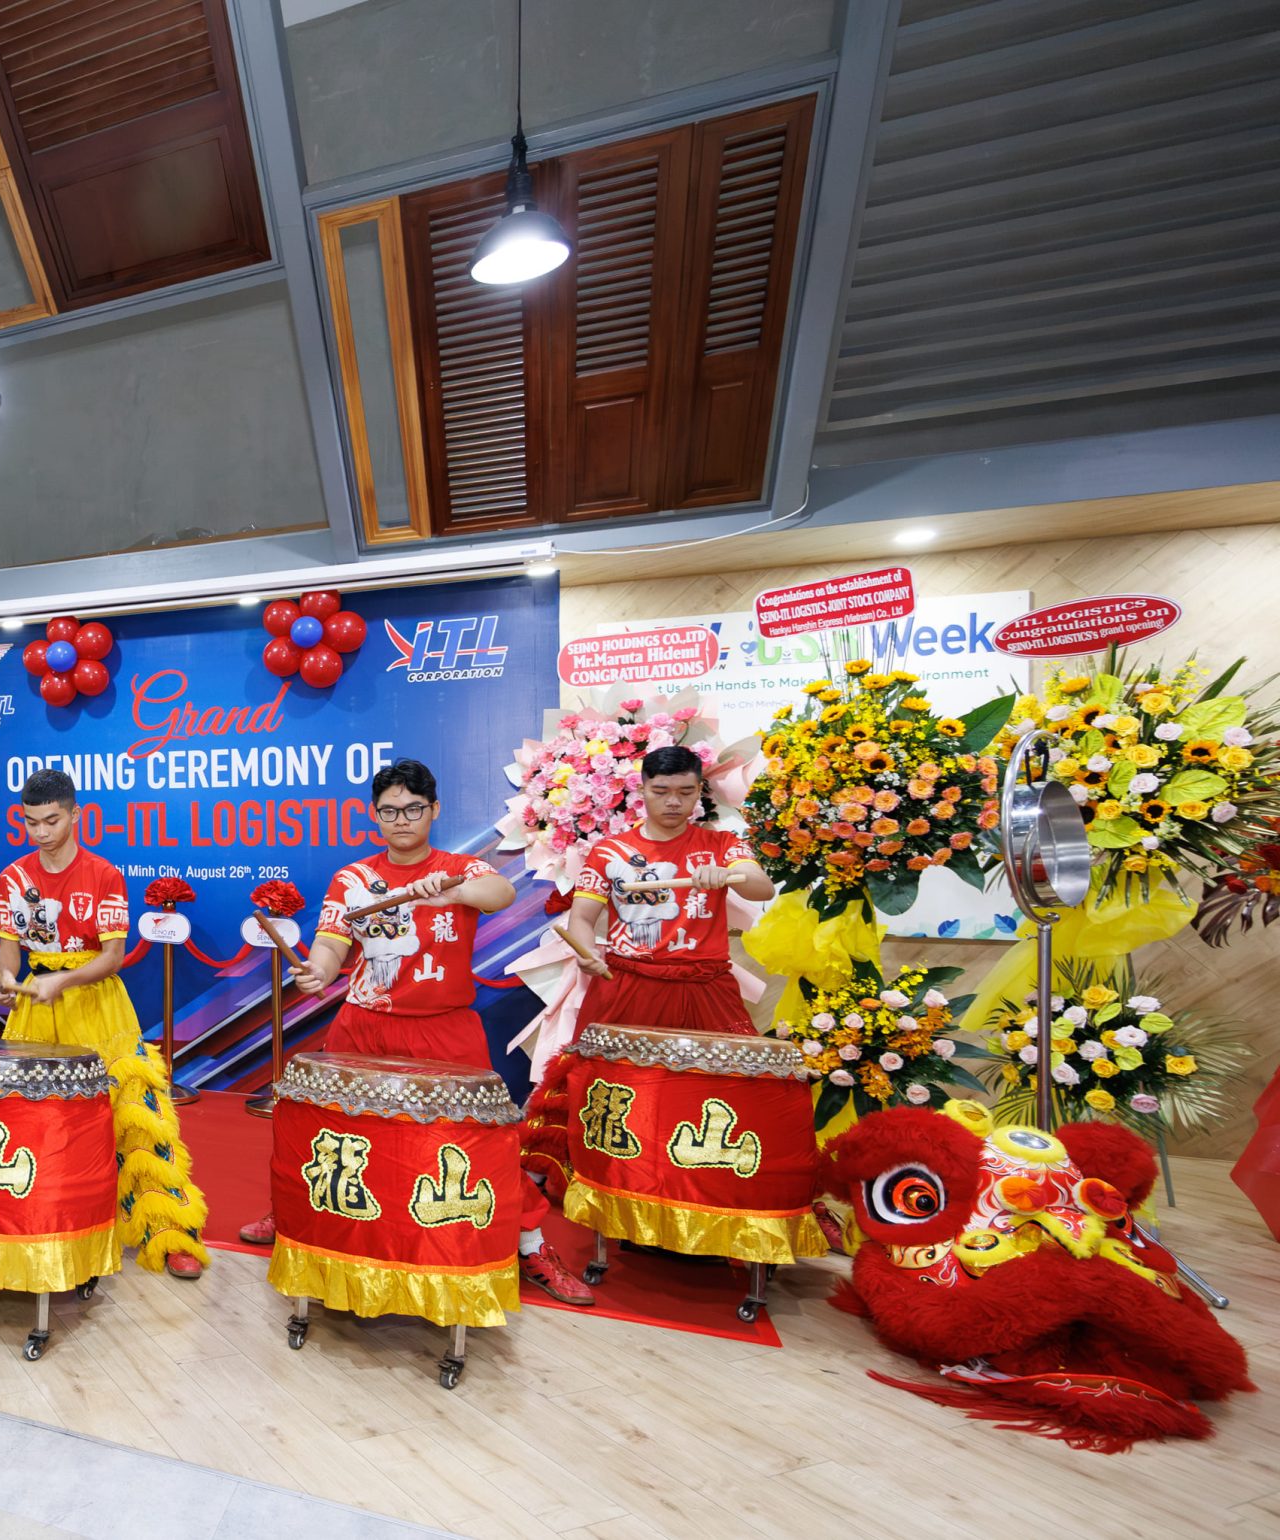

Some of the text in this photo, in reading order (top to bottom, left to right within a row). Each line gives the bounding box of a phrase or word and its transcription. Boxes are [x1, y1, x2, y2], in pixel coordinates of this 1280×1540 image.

[759, 569, 903, 607] Congratulations on the establishment of
[760, 586, 910, 624] SEINO-ITL LOGISTICS JOINT STOCK COMPANY
[792, 618, 817, 633] Hanshin
[818, 616, 843, 629] Express
[844, 611, 876, 626] (Vietnam)
[891, 605, 903, 616] Ltd
[1013, 599, 1148, 629] ITL LOGISTICS
[872, 612, 996, 659] Week
[997, 607, 1170, 642] Congratulations on
[1007, 638, 1047, 652] SEINO-ITL
[1099, 624, 1125, 639] grand
[1126, 618, 1165, 634] opening!
[407, 615, 508, 671] ITL
[568, 641, 600, 655] SEINO
[601, 634, 660, 651] HOLDINGS
[573, 643, 700, 670] Mr.Maruta Hidemi
[407, 667, 504, 683] CORPORATION
[570, 660, 705, 685] CONGRATULATIONS
[666, 683, 681, 694] Us
[690, 682, 712, 693] oin
[715, 677, 757, 692] Hands
[760, 678, 775, 689] To
[919, 668, 990, 681] ironment
[128, 669, 292, 759] Grand
[147, 744, 334, 790] CEREMONY
[346, 742, 394, 785] OF
[128, 864, 155, 877] Minh
[158, 864, 183, 880] City,
[186, 865, 226, 880] August
[258, 866, 289, 879] 2025
